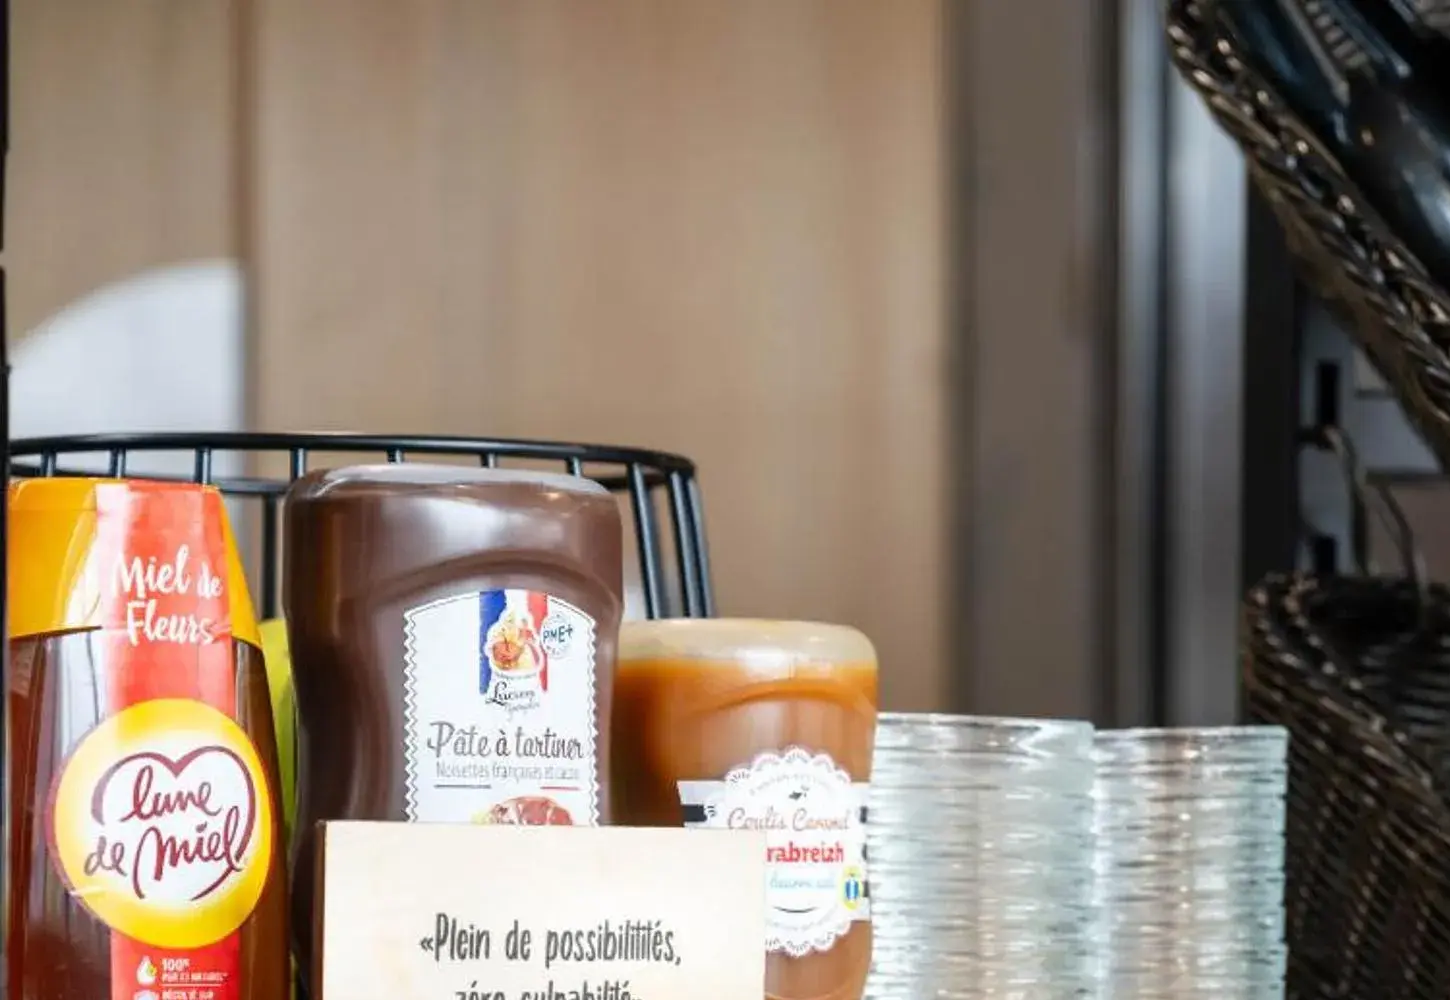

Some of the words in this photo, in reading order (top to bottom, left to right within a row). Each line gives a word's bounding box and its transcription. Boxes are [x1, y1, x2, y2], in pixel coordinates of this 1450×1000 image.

[110, 543, 191, 598] Miel
[197, 570, 223, 599] de
[126, 600, 216, 647] Fleurs
[427, 721, 491, 758] Pâte
[496, 729, 511, 757] à
[516, 726, 584, 760] tartiner
[119, 764, 222, 823] lune
[84, 835, 128, 878] de
[766, 841, 845, 863] rabreizh
[419, 912, 492, 962] «Plein
[505, 919, 532, 962] de
